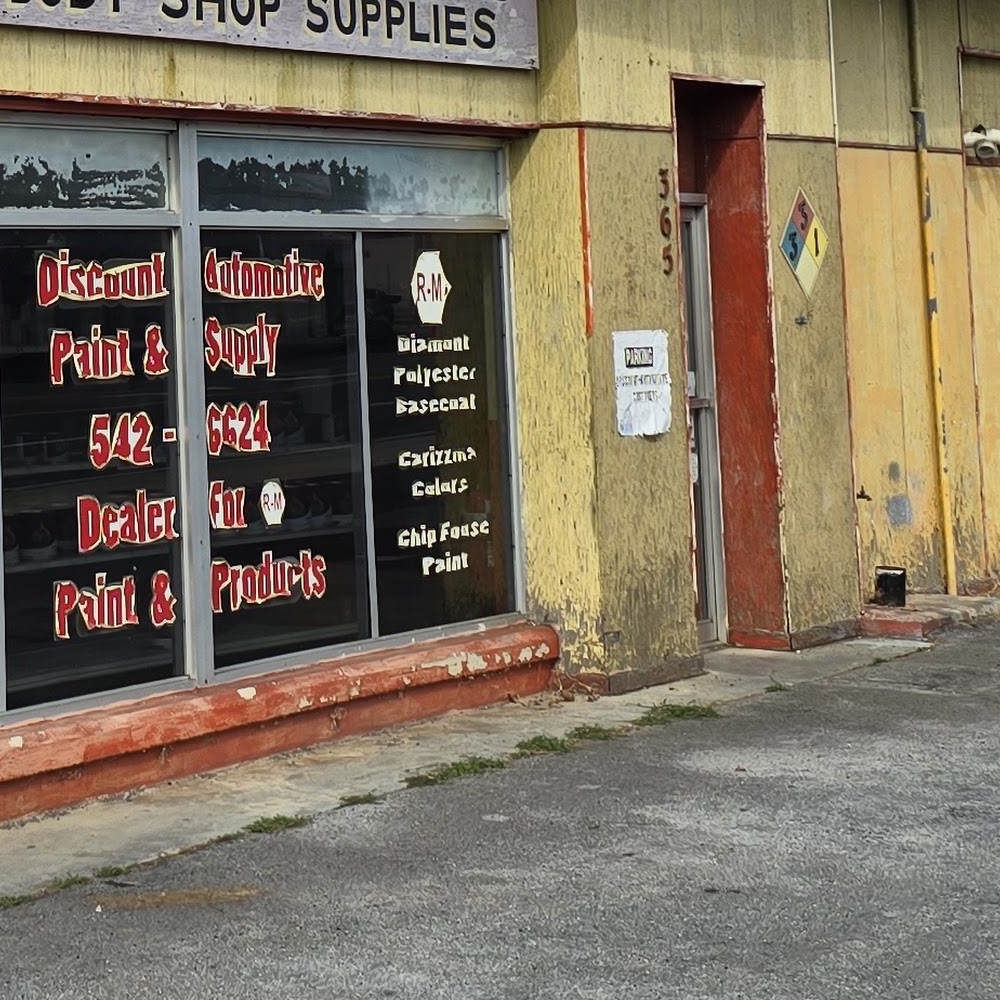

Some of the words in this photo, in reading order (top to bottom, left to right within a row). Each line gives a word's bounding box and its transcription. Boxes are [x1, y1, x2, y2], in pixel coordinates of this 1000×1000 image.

[36, 248, 169, 308] Discount
[204, 248, 325, 301] Automotive
[50, 324, 135, 385] Paint
[144, 324, 169, 376] &
[204, 313, 281, 377] Supply
[393, 364, 476, 387] Polyester
[411, 477, 469, 497] Colors
[77, 489, 179, 553] Dealer
[397, 524, 436, 548] Chip
[421, 551, 469, 576] Paint
[53, 572, 139, 639] Paint
[150, 569, 177, 628] &
[210, 550, 327, 613] Products
